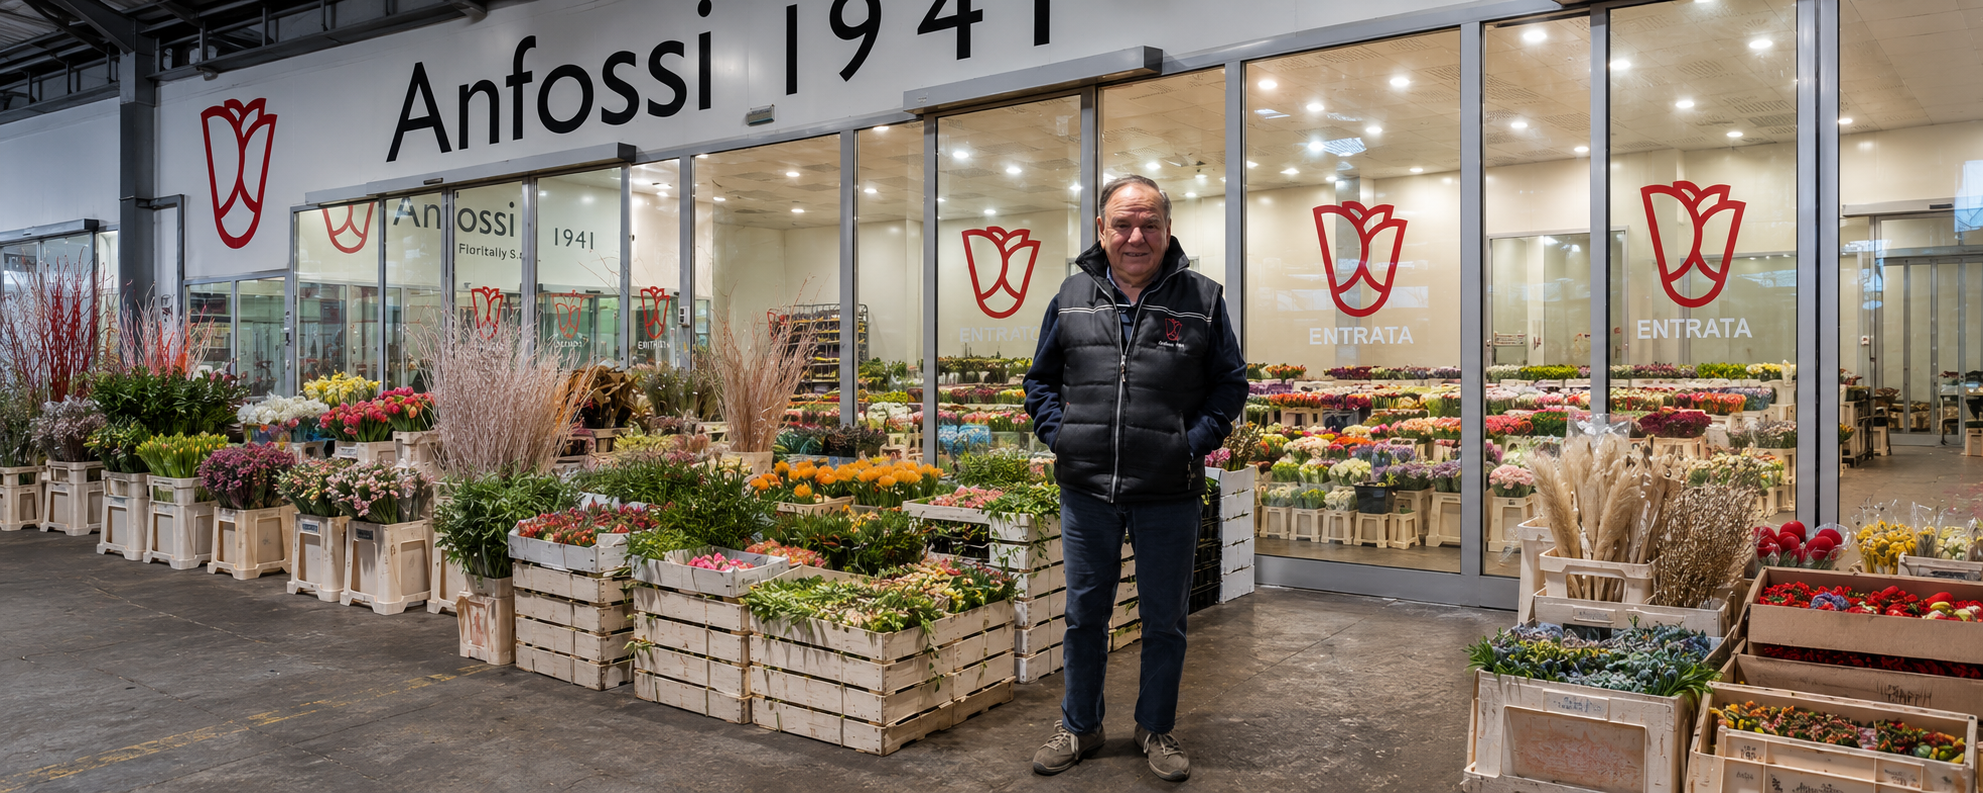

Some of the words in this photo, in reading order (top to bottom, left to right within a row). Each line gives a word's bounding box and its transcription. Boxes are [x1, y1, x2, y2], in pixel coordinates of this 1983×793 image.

[386, 0, 711, 162] Anfossi
[393, 192, 515, 237] Anossi
[554, 227, 594, 250] 1941
[1309, 325, 1414, 345] ENTRATA
[1637, 317, 1753, 339] ENTRATA
